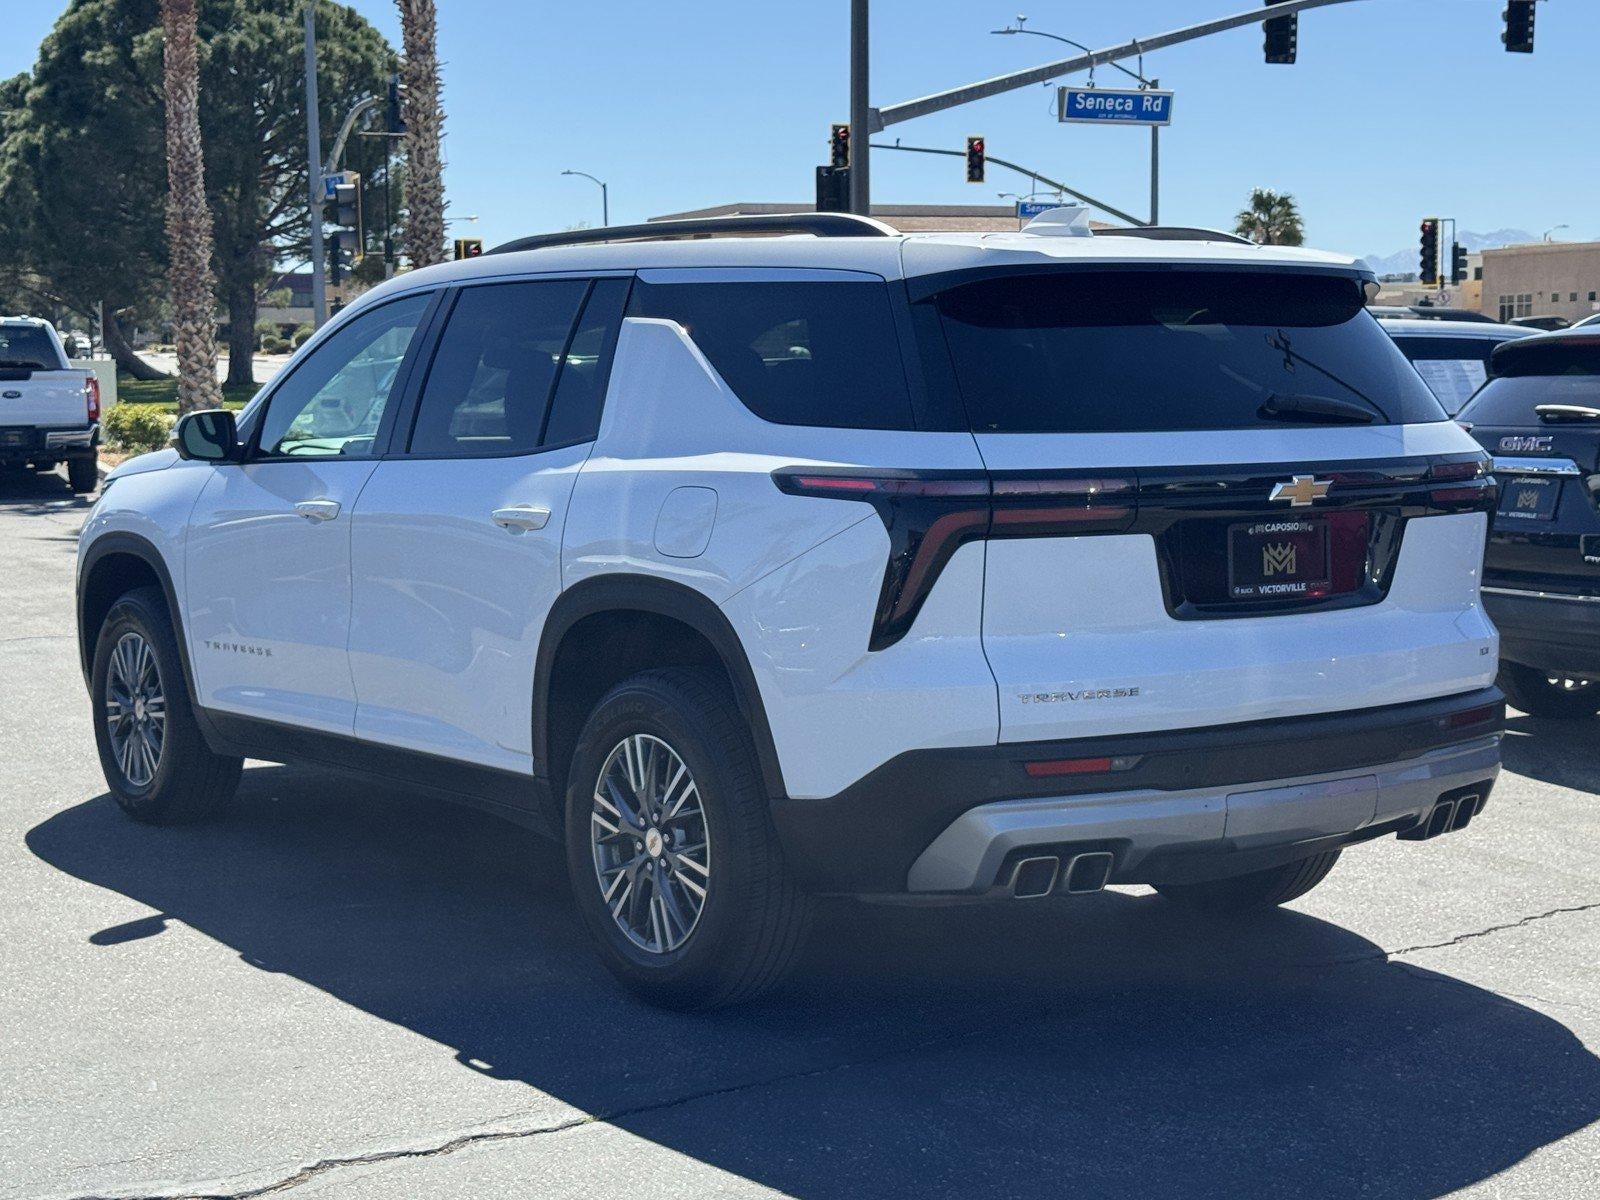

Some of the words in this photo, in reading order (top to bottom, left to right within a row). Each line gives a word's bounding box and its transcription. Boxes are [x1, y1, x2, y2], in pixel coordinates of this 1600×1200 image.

[1075, 93, 1134, 111] Seneca
[1142, 96, 1163, 112] Rd
[1499, 436, 1553, 452] GMC
[1264, 522, 1299, 532] CAPOSIO
[1258, 582, 1306, 594] VICTORVILLE
[203, 640, 273, 657] TRAVERSE
[1017, 687, 1140, 704] TRAVERSE
